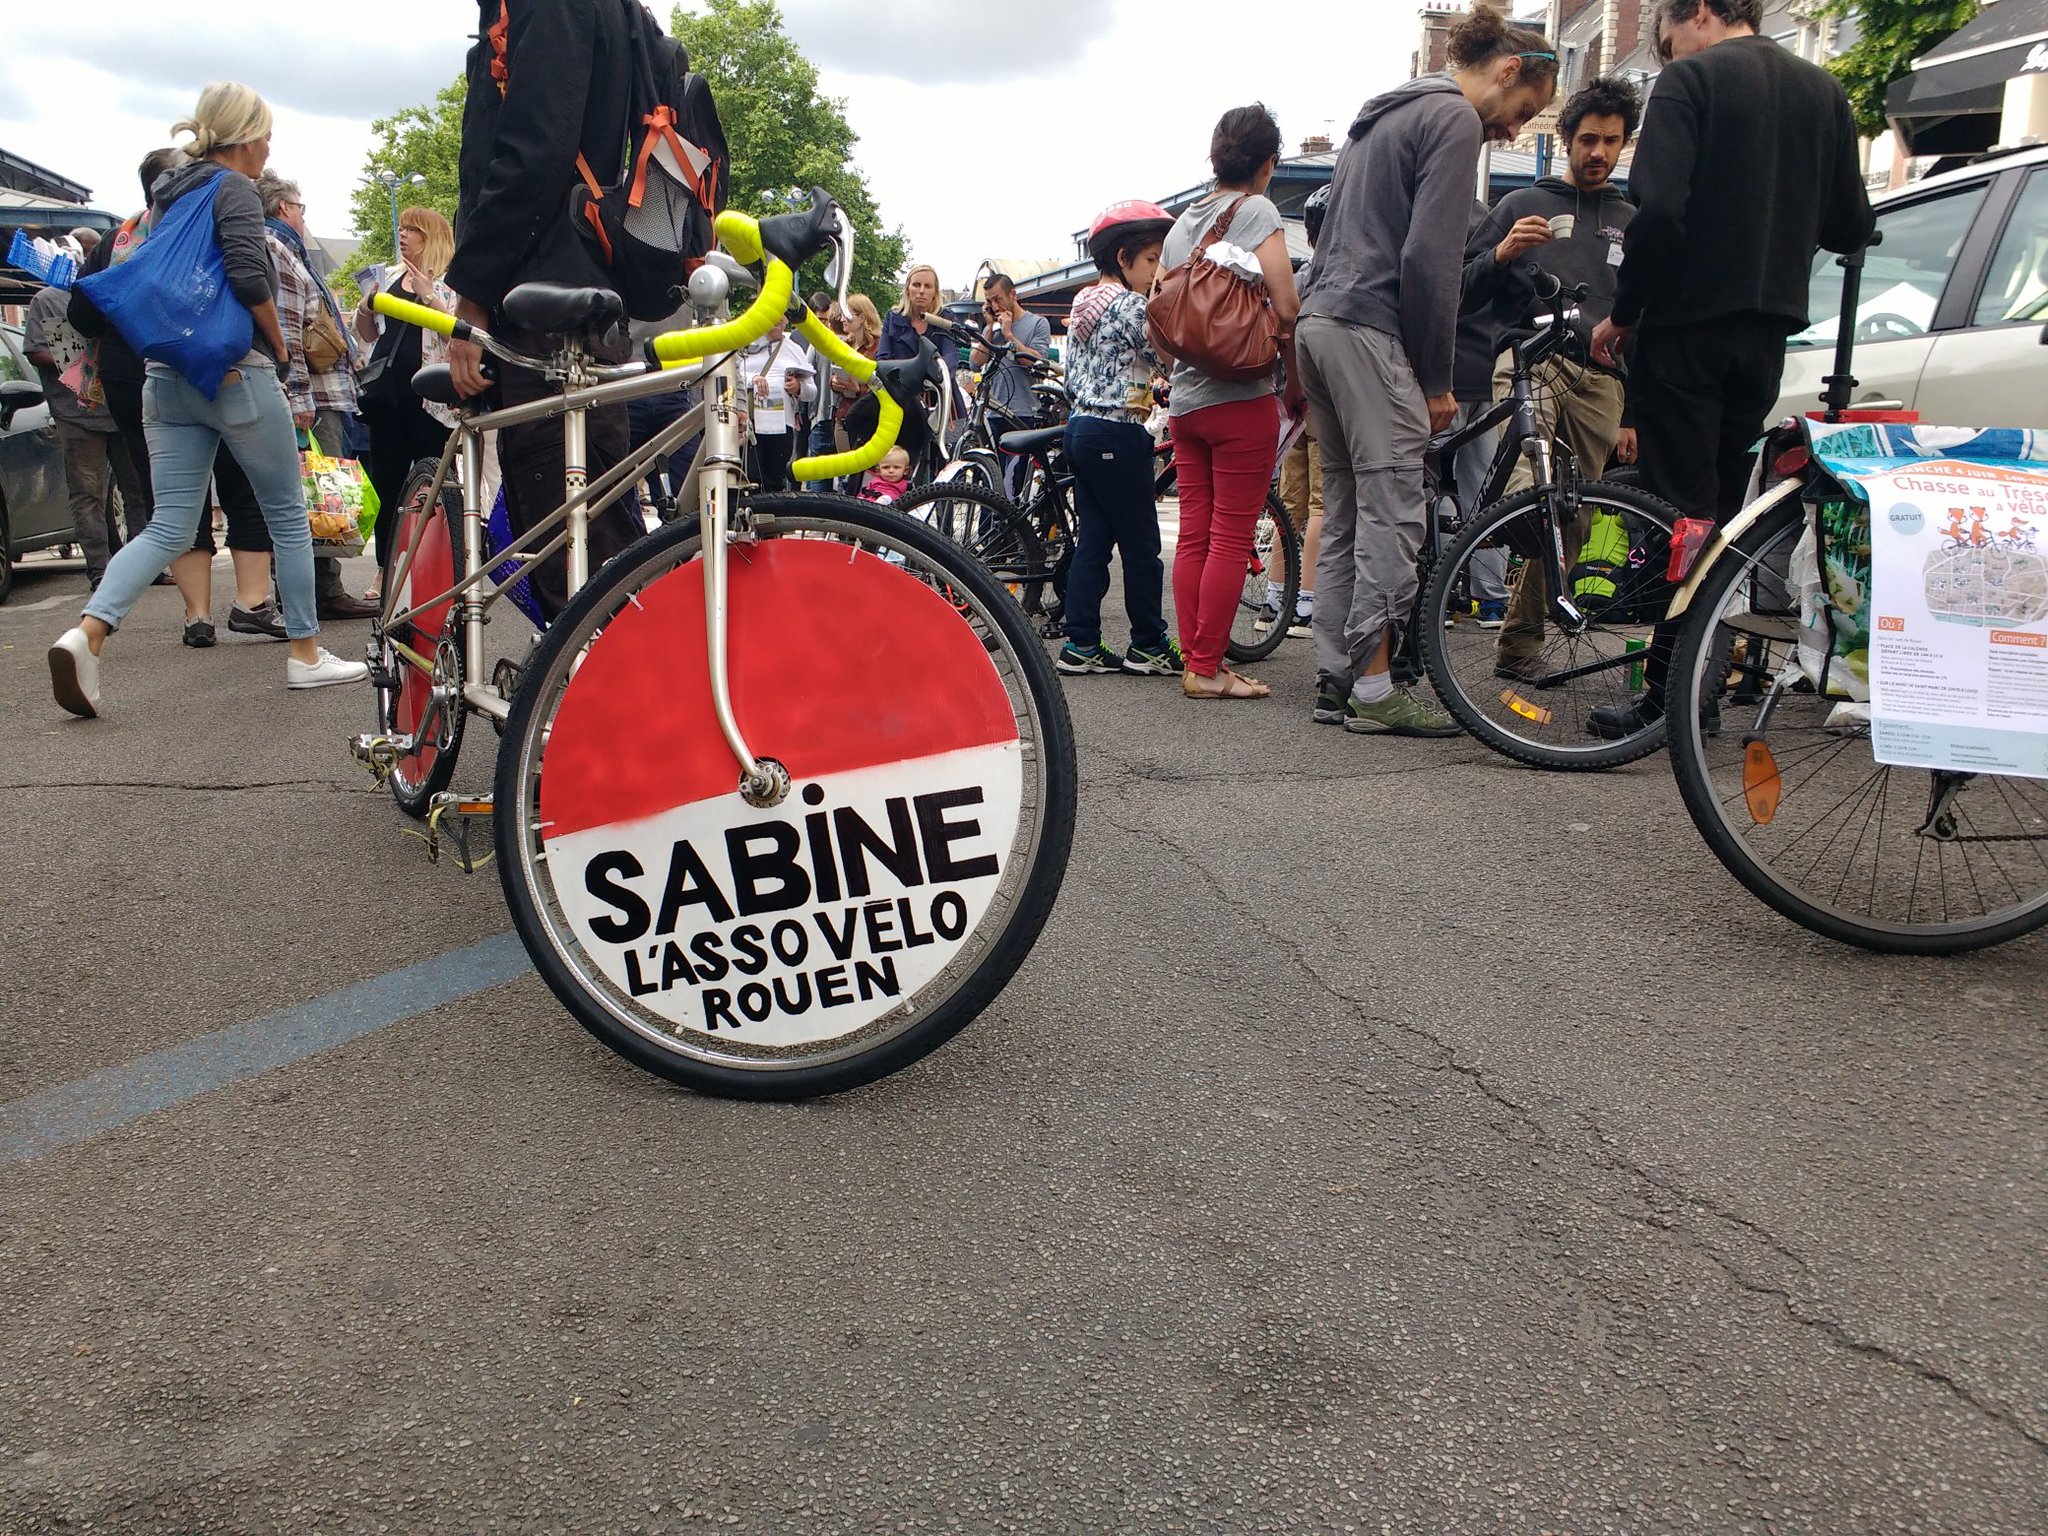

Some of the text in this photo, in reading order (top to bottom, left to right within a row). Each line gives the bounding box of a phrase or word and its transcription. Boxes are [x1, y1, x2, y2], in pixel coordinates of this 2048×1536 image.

[1955, 467, 1964, 475] 4
[1893, 476, 1970, 495] Chasse
[1978, 487, 1995, 497] au
[2007, 499, 2047, 515] vélo
[1890, 514, 1922, 522] GRATUIT
[1880, 618, 1894, 629] Où
[1992, 632, 2037, 646] Comment
[585, 783, 999, 943] SABINE
[624, 891, 967, 996] L'ASSO VÉLO
[702, 956, 902, 1030] ROUEN
